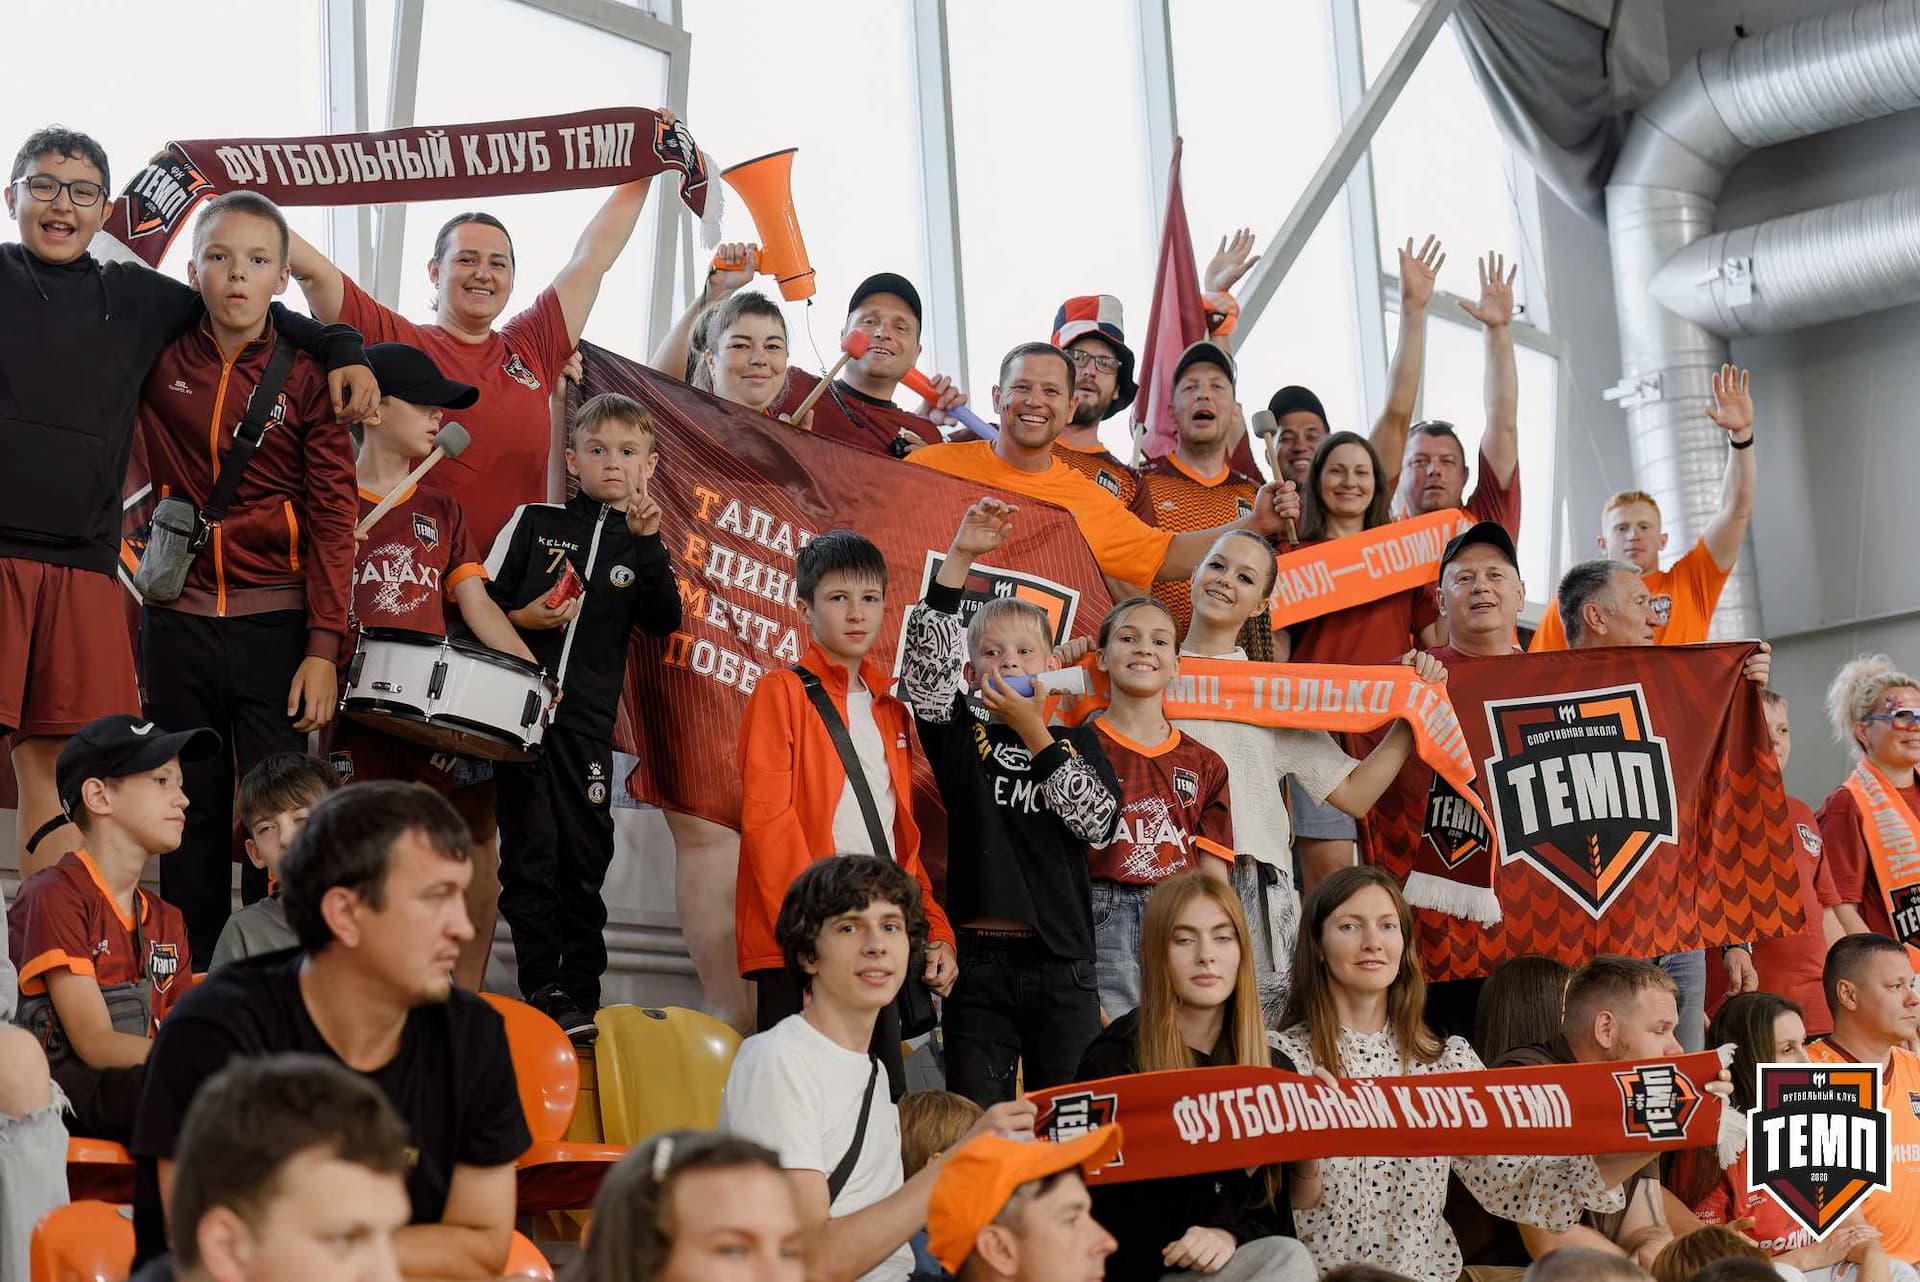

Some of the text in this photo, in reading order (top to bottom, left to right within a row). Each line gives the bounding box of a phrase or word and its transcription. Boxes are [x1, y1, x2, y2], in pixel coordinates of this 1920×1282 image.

[215, 129, 456, 186] ФУТБОЛЬНЫЙ
[459, 130, 551, 177] КЛУБ
[558, 122, 635, 170] ТЕМП
[133, 164, 188, 221] ТЕМП
[415, 523, 437, 543] ТЕМП
[538, 535, 580, 552] KELME
[545, 548, 566, 575] 7
[678, 576, 800, 666] МЕЧТА
[663, 630, 769, 697] ПОБЕ
[1250, 676, 1395, 715] ТОЛЬКО
[1526, 724, 1618, 747] СПОРТИВНАЯ ШКОЛА
[1507, 751, 1661, 836] ТЕМП
[1896, 905, 1920, 937] ТЕ
[1172, 1078, 1573, 1144] ФУТБОЛЬНЫЙ КЛУБ ТЕМП
[1642, 1069, 1679, 1135] ТЕМП
